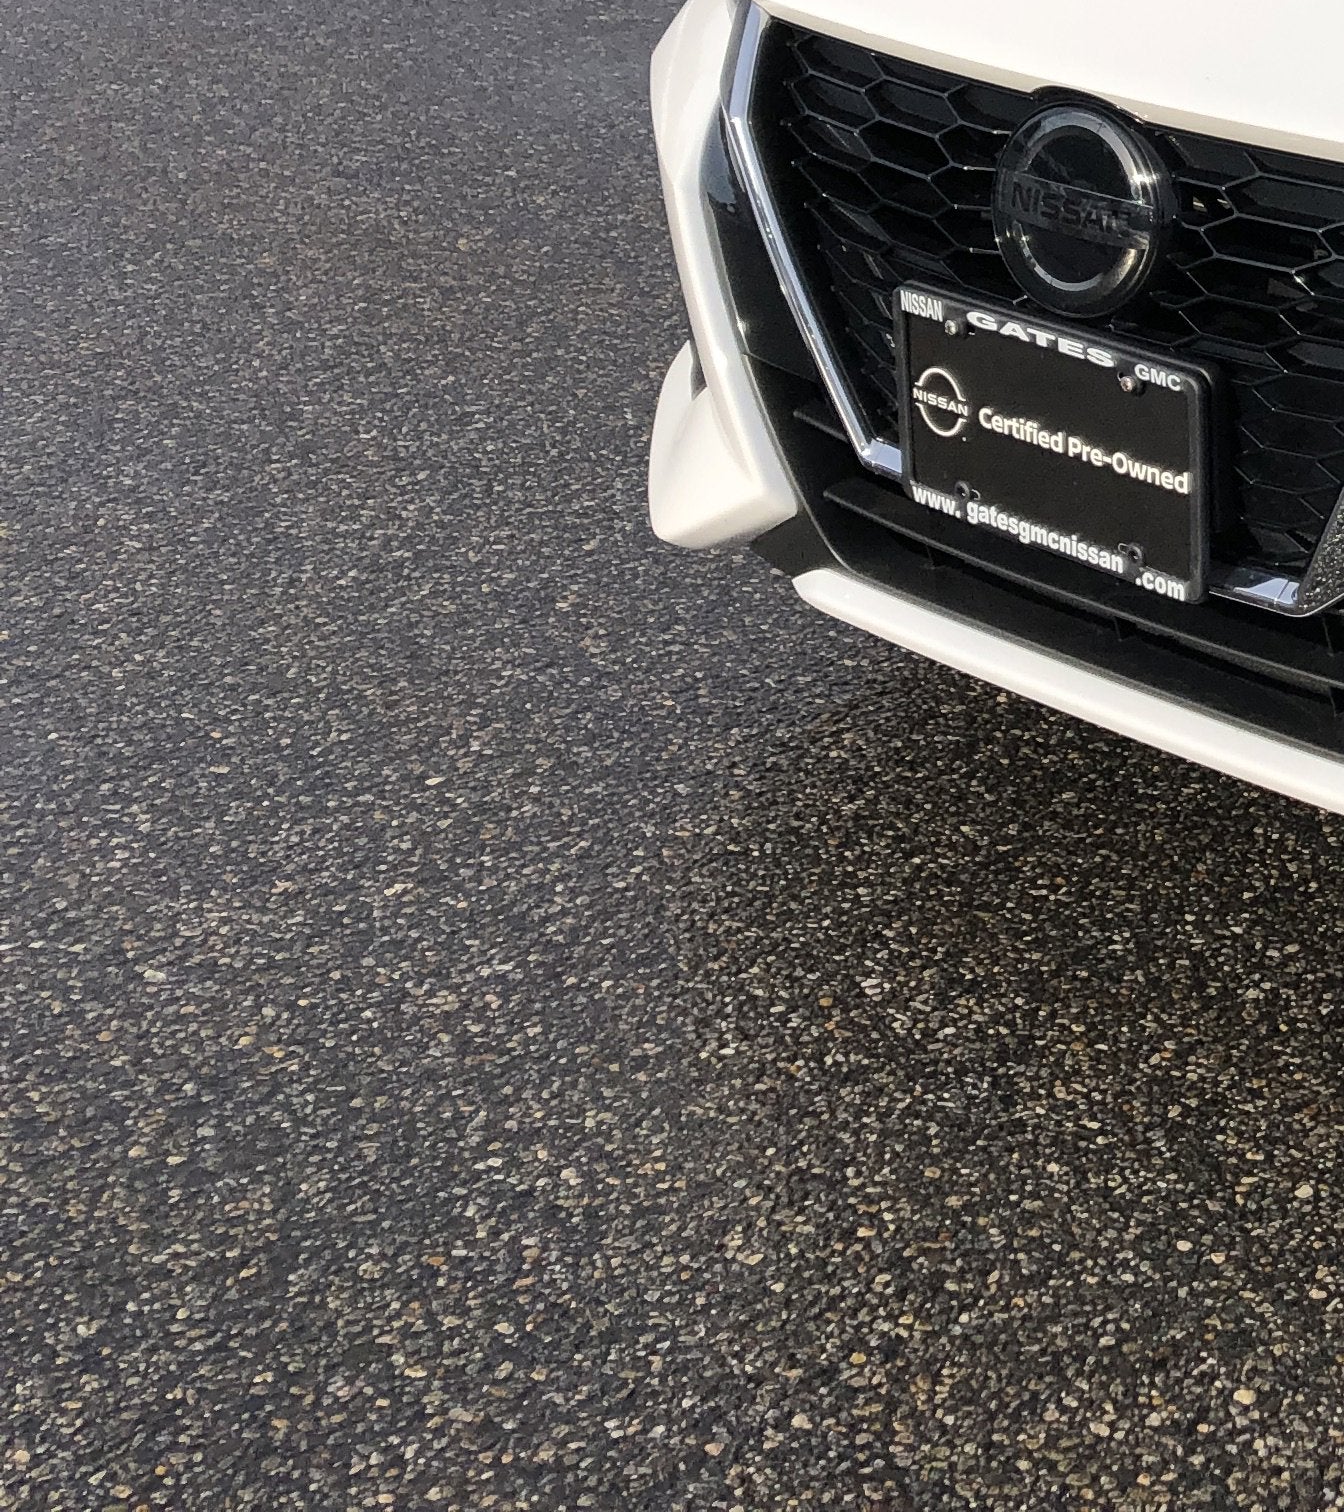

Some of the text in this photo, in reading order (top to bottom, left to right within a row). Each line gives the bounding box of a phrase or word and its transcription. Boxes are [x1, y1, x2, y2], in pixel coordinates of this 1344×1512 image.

[900, 289, 1182, 392] NISSAN GATES GMC
[912, 387, 968, 417] NISSAN
[978, 406, 1190, 495] Certified Pre-Owned
[911, 484, 1185, 602] www. gatesgmcnissan .com
